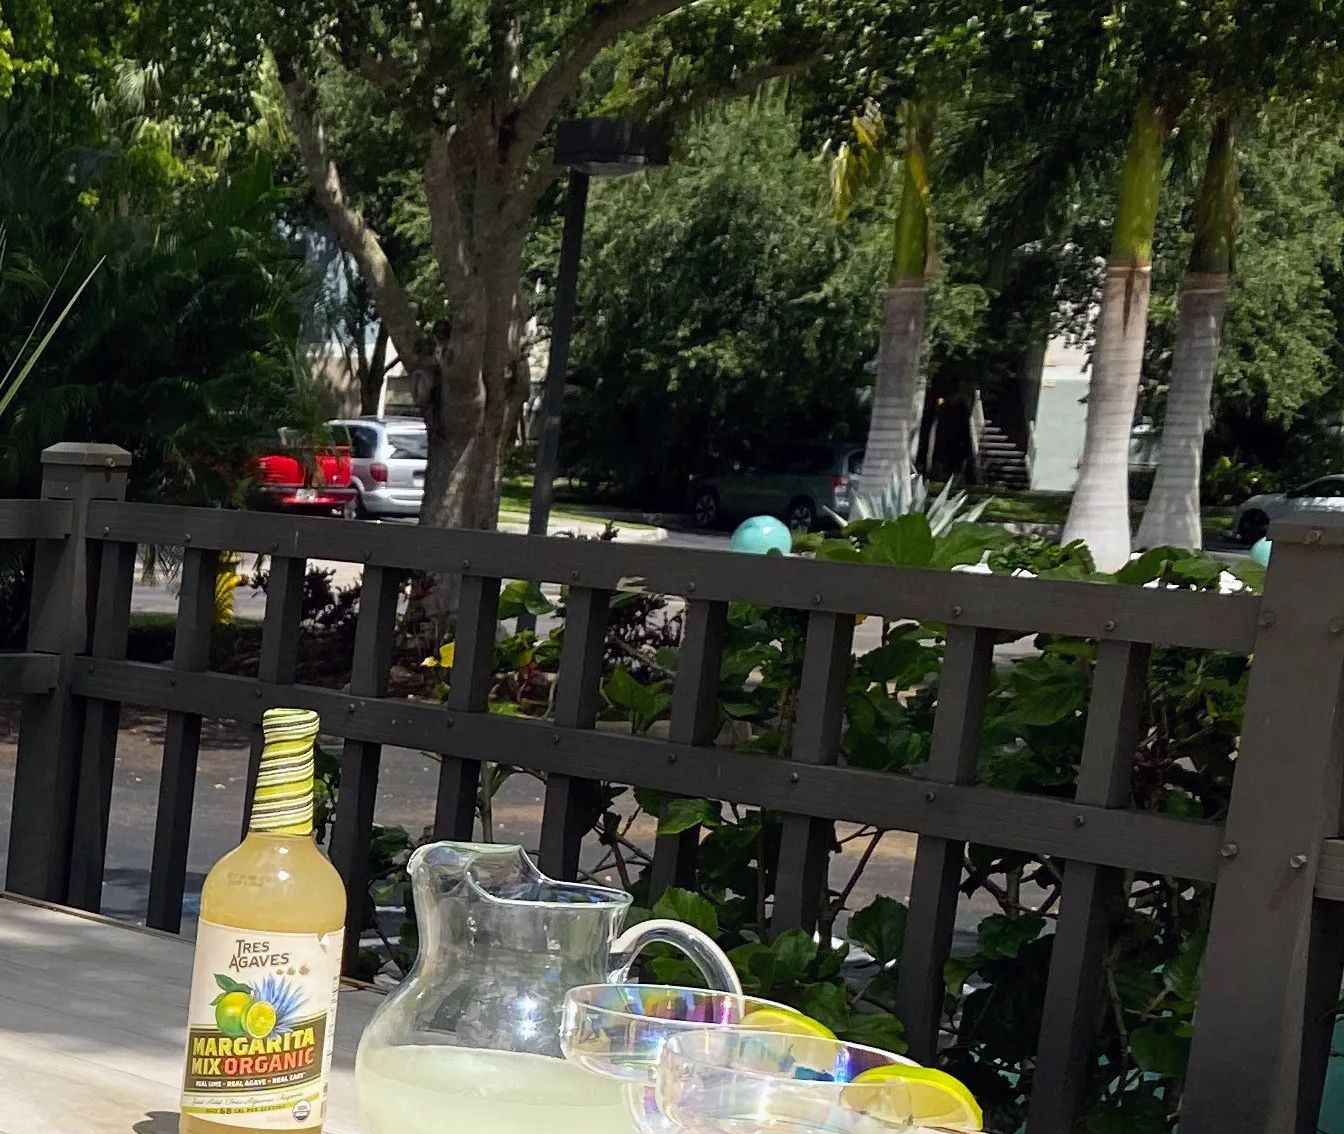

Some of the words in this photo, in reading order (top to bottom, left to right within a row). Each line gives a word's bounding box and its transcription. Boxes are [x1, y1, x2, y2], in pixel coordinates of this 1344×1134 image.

[193, 1027, 315, 1057] MARGARITA
[191, 1056, 222, 1076] MIX
[223, 1046, 314, 1076] ORGANIC
